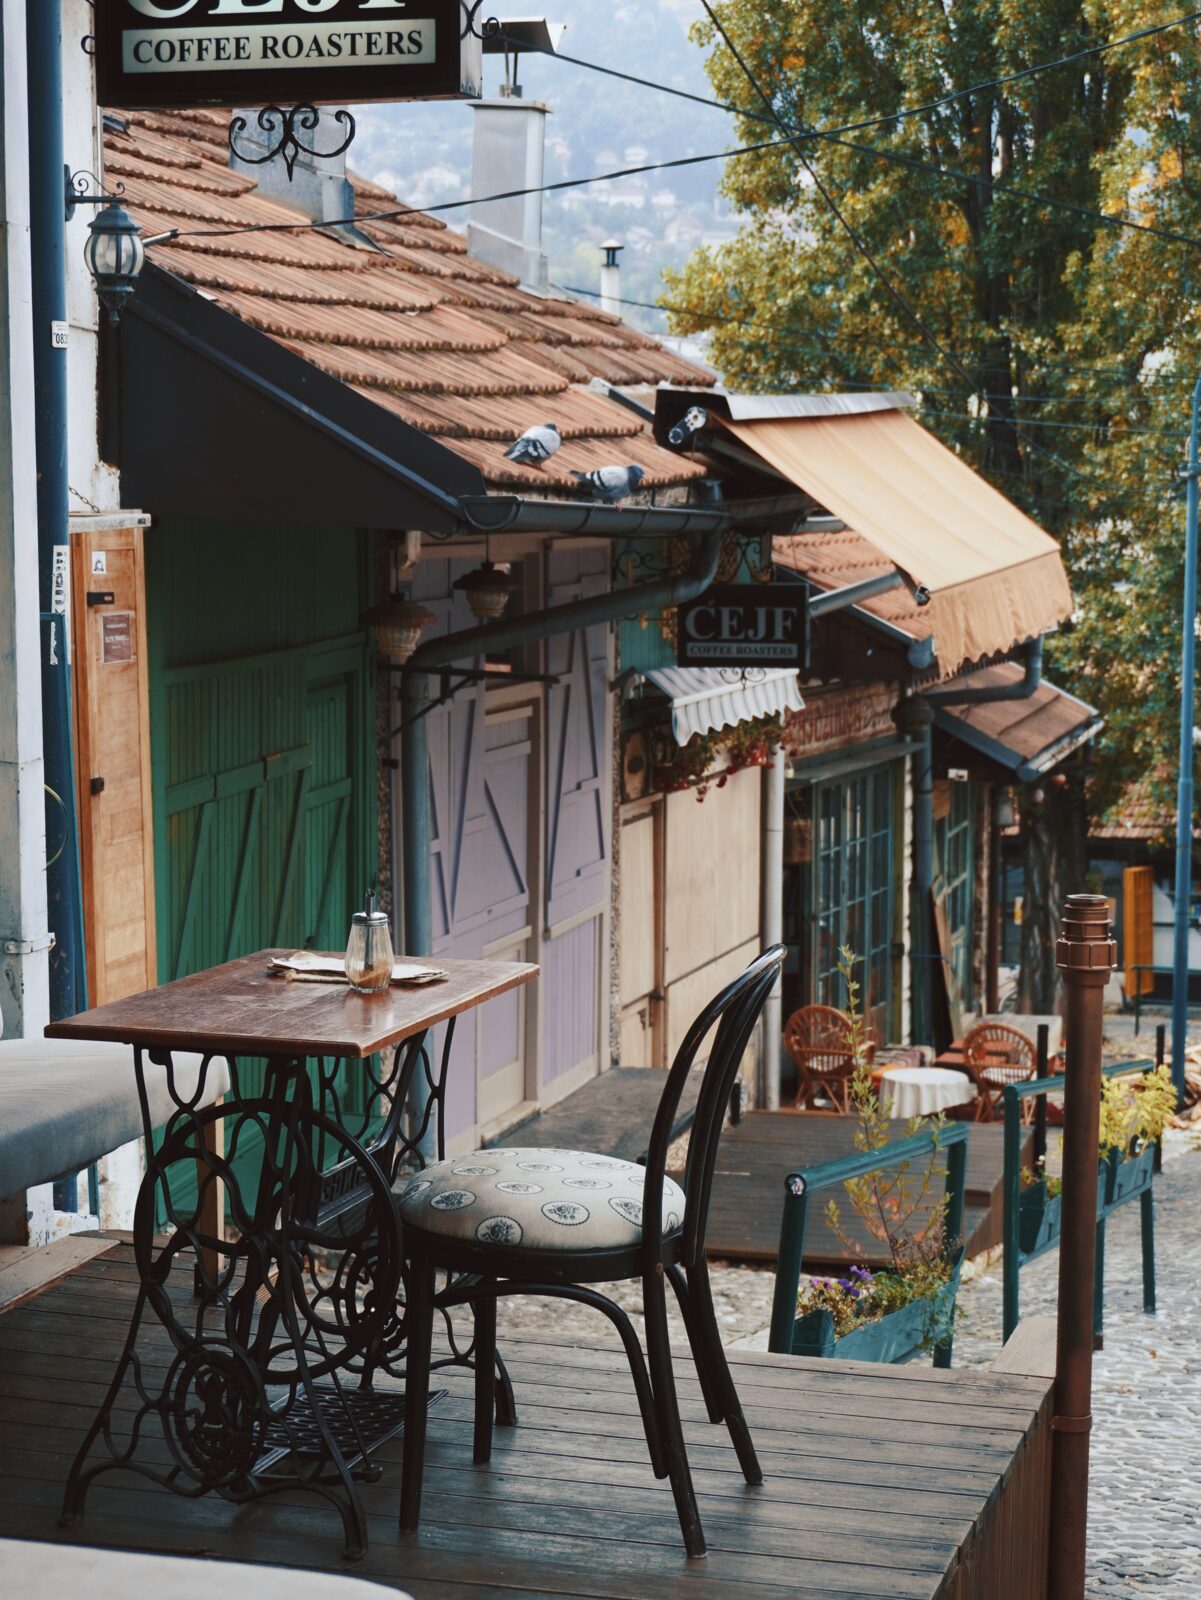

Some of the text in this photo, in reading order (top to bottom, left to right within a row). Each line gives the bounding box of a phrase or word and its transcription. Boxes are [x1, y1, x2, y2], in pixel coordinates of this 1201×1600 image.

[133, 30, 423, 64] COFFEE ROASTERS
[690, 645, 793, 656] COFFEE ROASTERS
